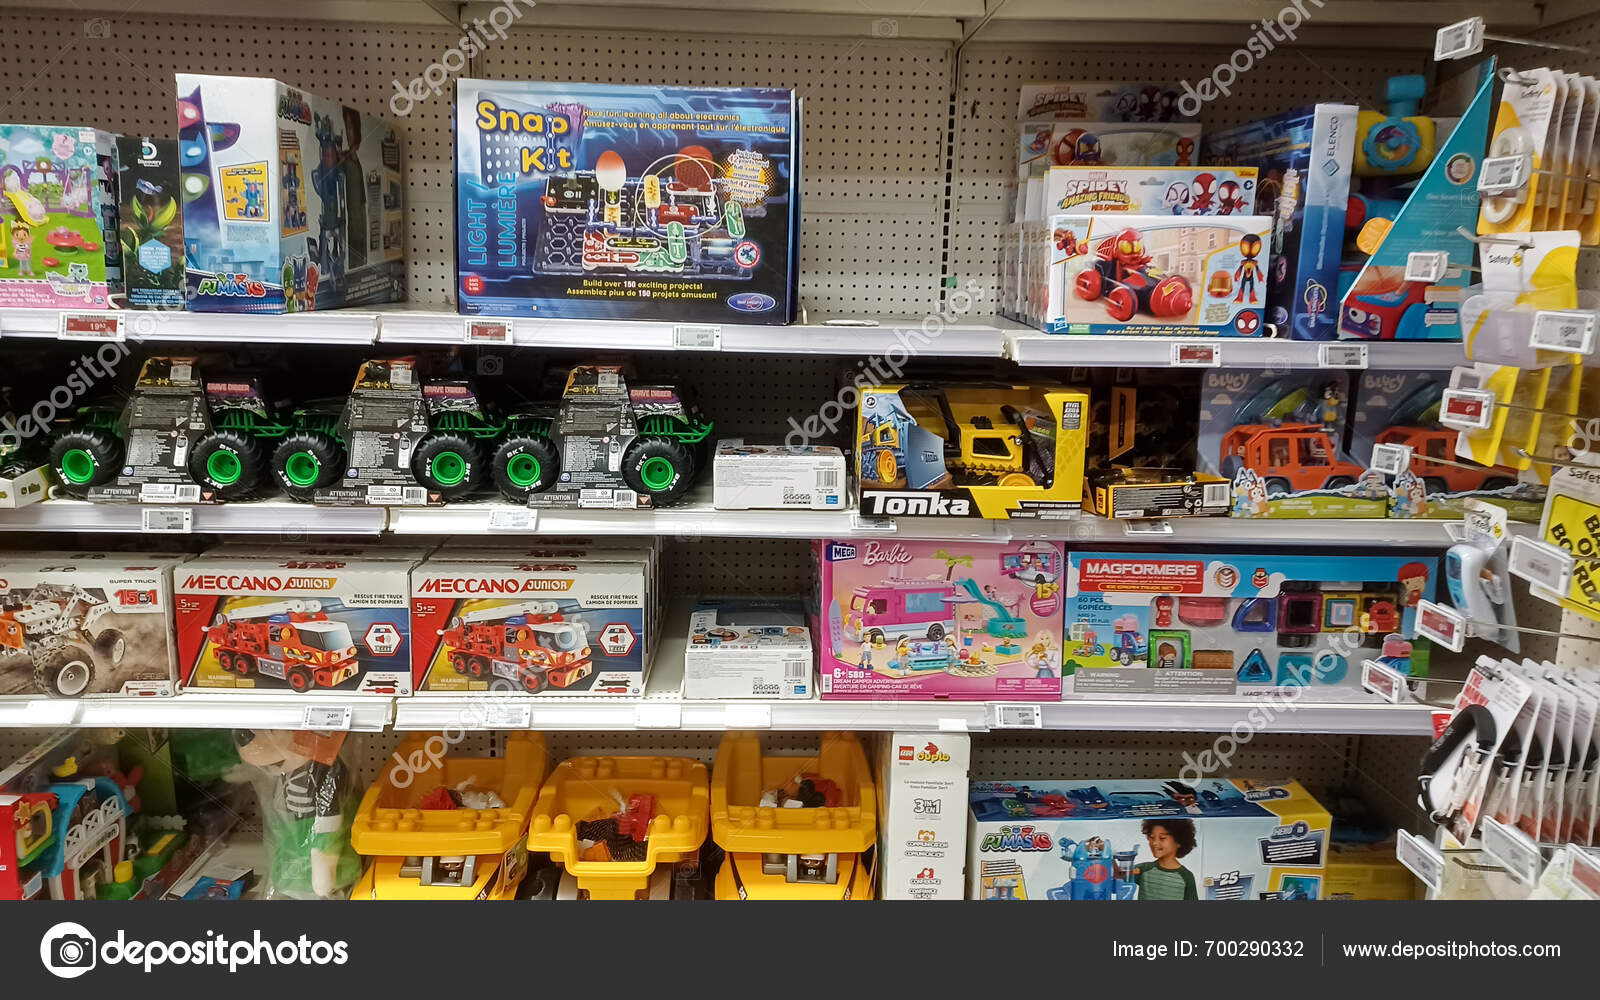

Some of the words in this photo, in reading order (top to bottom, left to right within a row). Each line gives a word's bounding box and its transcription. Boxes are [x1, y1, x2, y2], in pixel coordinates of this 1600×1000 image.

[477, 100, 569, 134] Snap
[606, 110, 619, 118] fun
[621, 111, 655, 121] learning
[658, 112, 667, 120] all
[670, 112, 693, 121] about
[696, 113, 740, 121] electronics
[583, 120, 637, 129] Amusez-vous
[652, 123, 694, 131] apprenant
[697, 123, 713, 131] tout
[1326, 116, 1339, 157] ELENCO
[1066, 179, 1128, 197] SPIDEY
[1061, 192, 1098, 210] AMAZING
[468, 198, 488, 266] LIGHT
[566, 287, 607, 296] Assemblez
[608, 288, 625, 297] plus
[627, 289, 636, 297] de
[652, 290, 680, 299] projets
[681, 291, 717, 299] amusant!
[583, 279, 602, 288] Build
[604, 280, 621, 288] over
[637, 281, 668, 290] exciting
[669, 282, 703, 291] projects!
[219, 443, 239, 455] BKT
[506, 446, 525, 459] BKT
[85, 448, 100, 467] BKT
[307, 449, 322, 467] BKT
[634, 453, 648, 472] BKT
[424, 457, 432, 478] BKT
[463, 462, 472, 483] BKT
[277, 469, 292, 488] BKT
[669, 473, 681, 492] BKT
[1568, 467, 1600, 485] Safet
[103, 488, 131, 496] ATTENTION
[329, 490, 358, 498] ATTENTION
[524, 479, 542, 493] BKT
[863, 491, 970, 516] Tonka
[833, 546, 856, 559] MEGA
[863, 542, 913, 566] Barbie
[1086, 563, 1198, 576] MAGFORMERS
[181, 575, 282, 591] MECCANO
[289, 578, 330, 590] JUNIOR
[417, 578, 520, 593] MECCANO
[527, 580, 568, 591] JUNIOR
[833, 668, 846, 679] 6+
[917, 751, 951, 764] duplo
[913, 798, 925, 814] 3
[1219, 871, 1239, 885] 25
